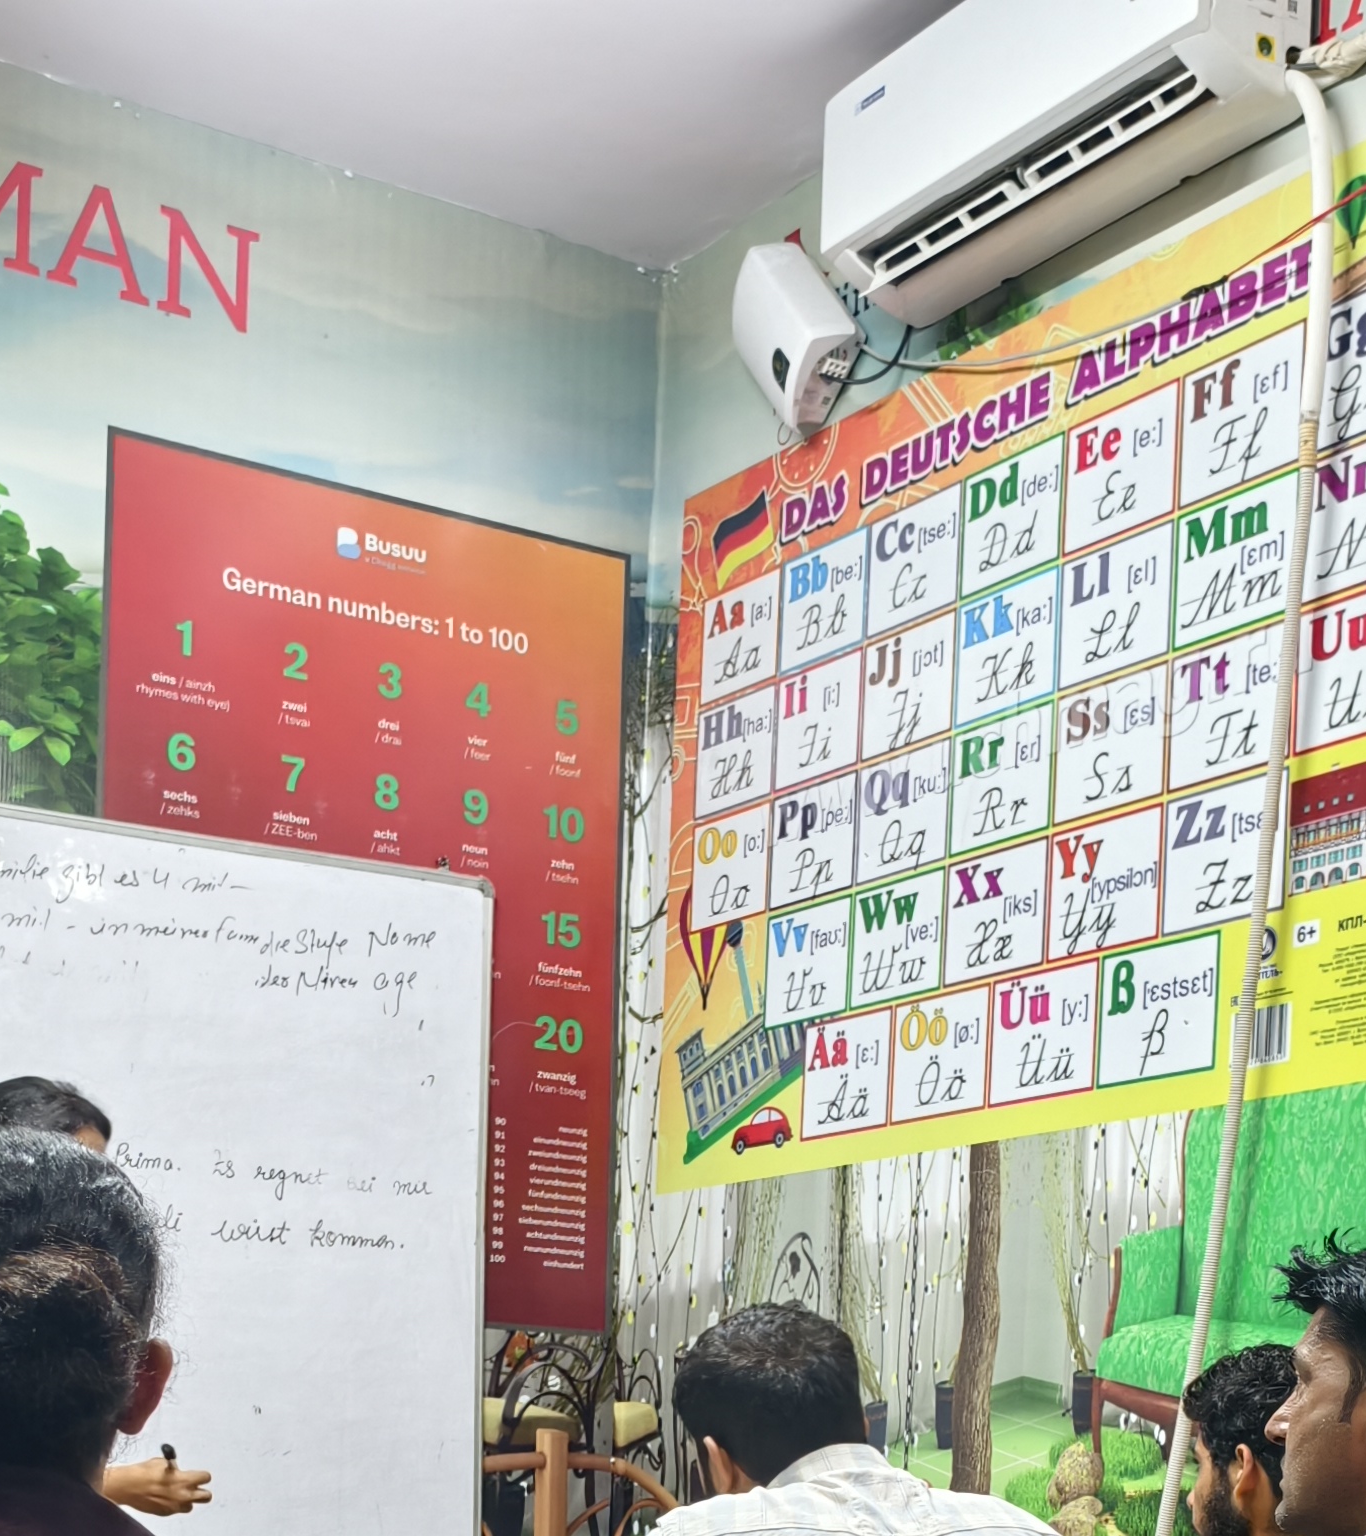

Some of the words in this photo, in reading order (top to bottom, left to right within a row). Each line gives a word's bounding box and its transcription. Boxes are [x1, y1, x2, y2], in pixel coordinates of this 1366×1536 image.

[781, 474, 848, 540] DAS
[864, 372, 1054, 501] DEUTSCHE
[1069, 240, 1313, 405] ALPHABET
[1191, 359, 1240, 423] Ff
[1074, 426, 1121, 474] Ee
[968, 462, 1019, 522] Dd
[365, 532, 427, 563] Busuu
[876, 520, 915, 562] Cc
[1183, 502, 1268, 564] Mm
[789, 555, 828, 603] Bb
[1070, 552, 1110, 607] Ll
[222, 567, 322, 609] German
[327, 594, 440, 636] numbers:
[444, 617, 454, 639] 1
[460, 621, 484, 645] to
[488, 627, 529, 654] 100
[707, 600, 744, 639] Aa
[963, 595, 1014, 649] Kk
[175, 620, 194, 657] 1
[283, 643, 308, 680] 2
[378, 662, 402, 699] 3
[869, 637, 902, 688] Jj
[1181, 652, 1230, 703] Tt
[465, 682, 491, 718] 4
[555, 699, 579, 735] 5
[784, 675, 807, 719] Ii
[377, 717, 400, 732] drei
[702, 705, 742, 750] Hh
[1067, 697, 1110, 744] Ss
[167, 733, 197, 771] 6
[281, 754, 305, 793] 7
[958, 735, 1005, 779] Rr
[374, 773, 400, 811] 8
[463, 789, 489, 826] 9
[864, 769, 910, 815] Qq
[373, 828, 399, 843] acht
[543, 803, 586, 843] 10
[777, 800, 817, 840] Pp
[1171, 800, 1227, 850] Zz
[698, 827, 737, 864] Oo
[1055, 834, 1104, 884] Yy
[953, 864, 1004, 908] Xx
[541, 911, 582, 949] 15
[859, 889, 919, 933] Ww
[772, 918, 809, 957] Vv
[1297, 925, 1317, 943] 6+
[999, 981, 1051, 1030] Üü
[534, 1015, 584, 1055] 20
[807, 1027, 848, 1071] Ää
[900, 1005, 948, 1052] Öö
